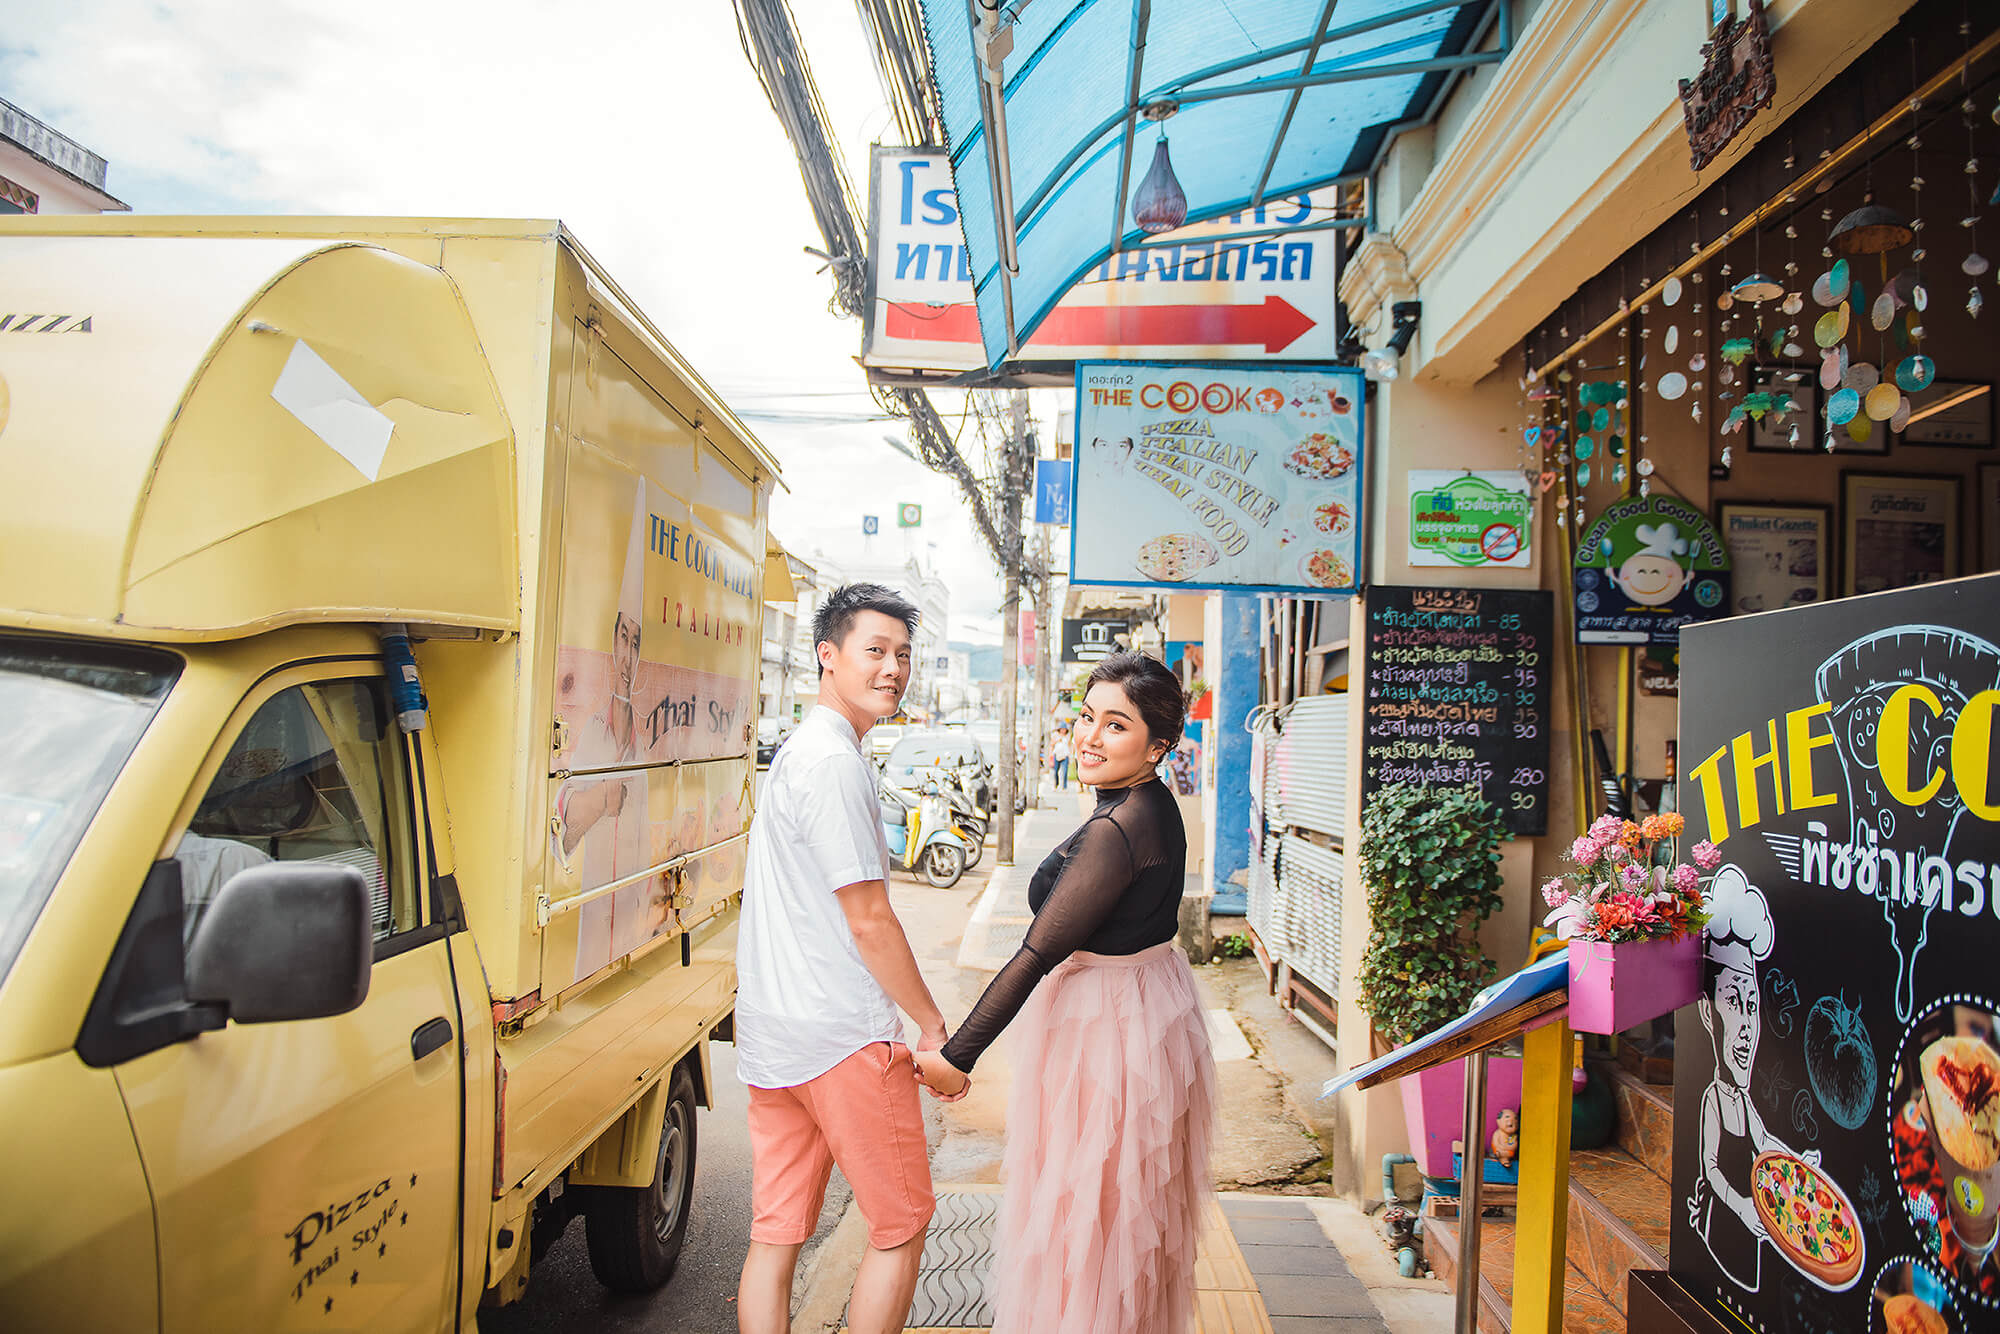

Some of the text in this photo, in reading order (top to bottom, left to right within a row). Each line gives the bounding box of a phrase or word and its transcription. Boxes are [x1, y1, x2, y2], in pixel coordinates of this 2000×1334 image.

[1088, 381, 1252, 414] THE COOK
[1126, 374, 1134, 385] 2
[1140, 418, 1215, 438] PIZZA
[1139, 436, 1258, 475] ITALIAN
[1134, 460, 1250, 557] THAI FOOD
[1138, 449, 1280, 528] THAI STYLE
[649, 513, 680, 562] THE
[1577, 498, 1724, 567] Clean Food Good Taste
[663, 596, 744, 648] ITALIAN
[645, 693, 697, 750] Thai
[1688, 700, 1839, 846] THE
[1510, 791, 1536, 810] 90
[284, 1175, 392, 1267] Pizza
[290, 1199, 399, 1304] Thai Style
